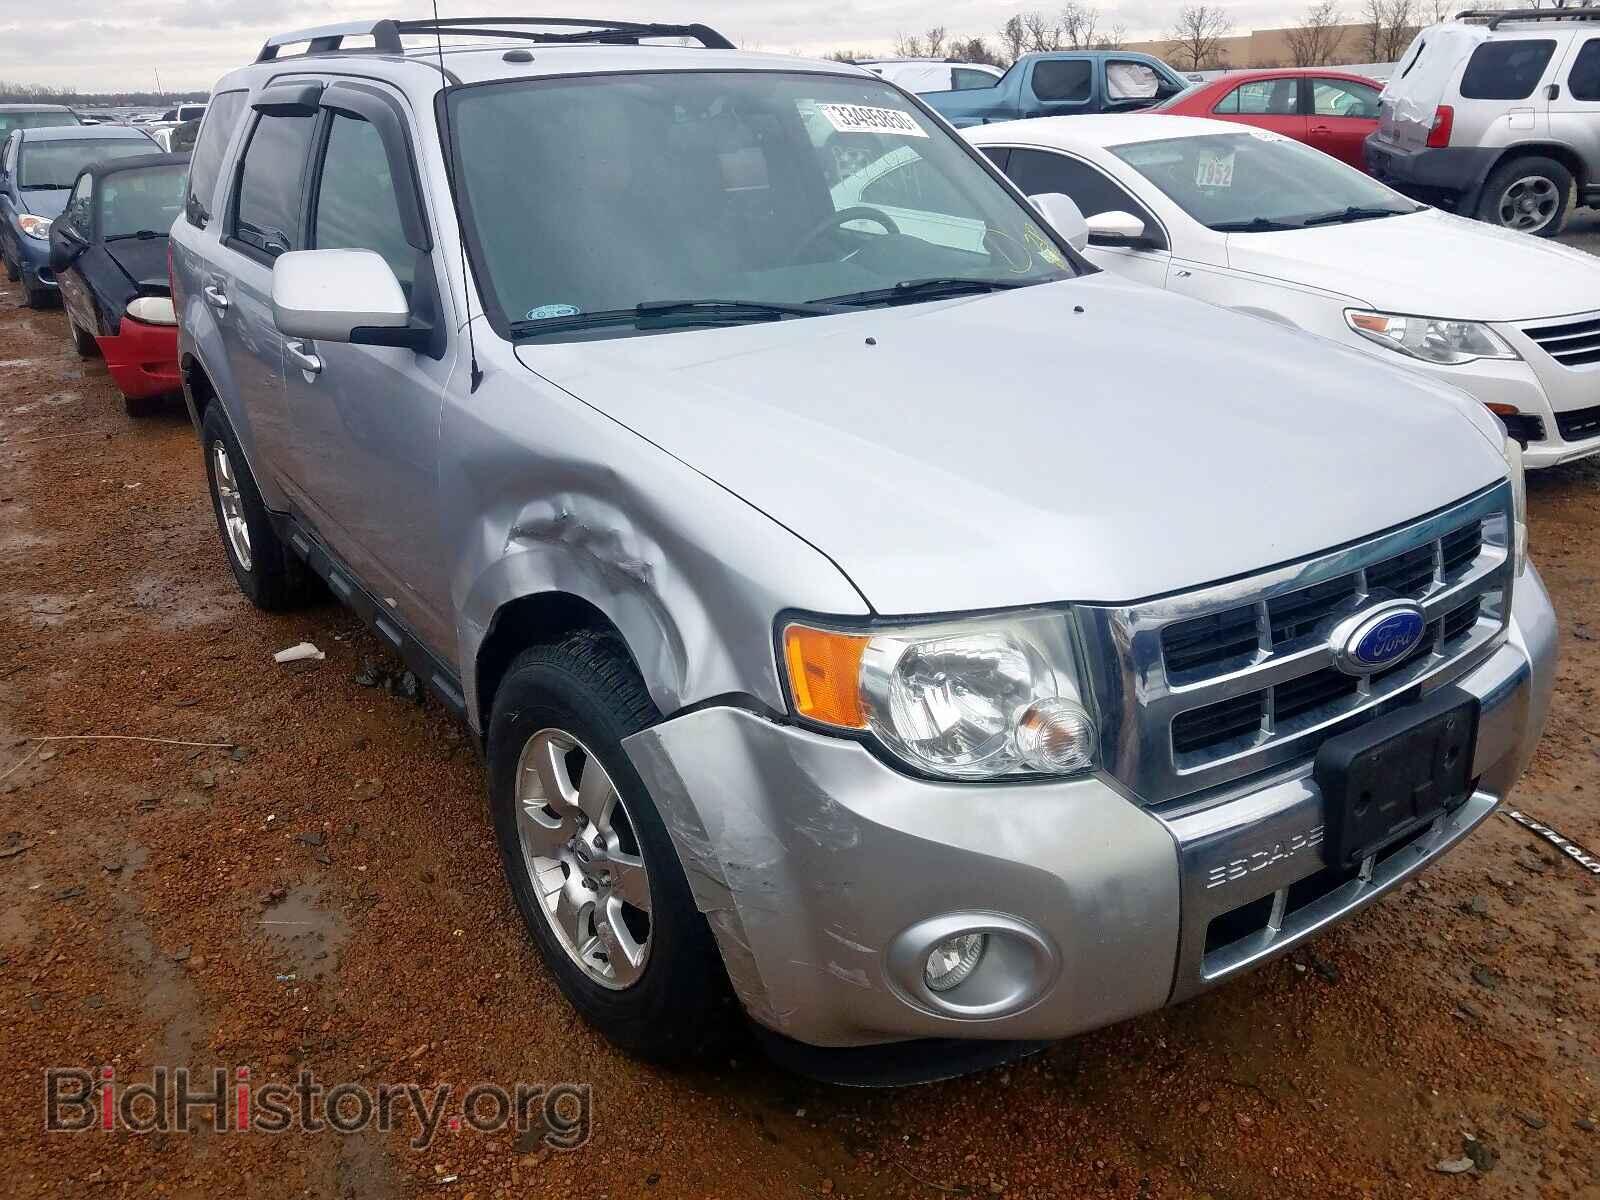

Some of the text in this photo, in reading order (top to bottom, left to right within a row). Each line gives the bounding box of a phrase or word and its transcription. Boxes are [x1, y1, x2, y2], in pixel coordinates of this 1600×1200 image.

[831, 105, 913, 130] 33495850
[1373, 620, 1413, 657] Ford
[1206, 825, 1325, 889] ESCAPE
